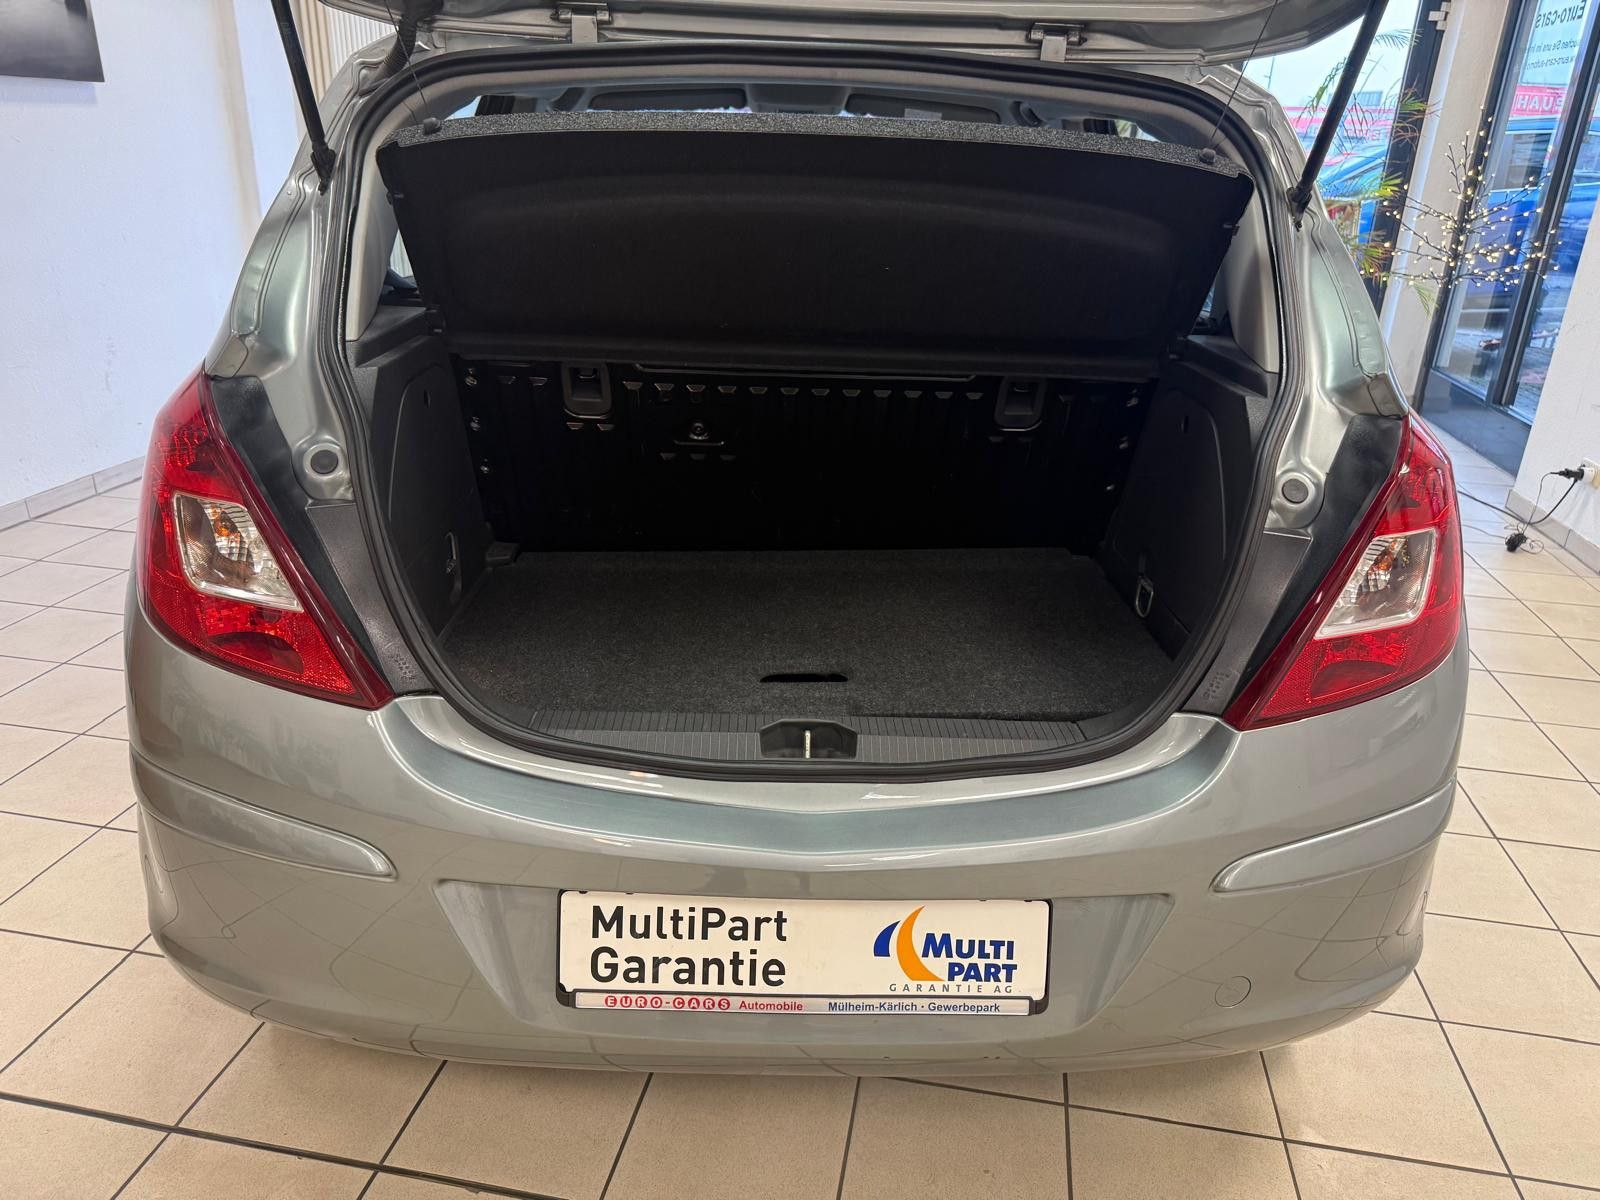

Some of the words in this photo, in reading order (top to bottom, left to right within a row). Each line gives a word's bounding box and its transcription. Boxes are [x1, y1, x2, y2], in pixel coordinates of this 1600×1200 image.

[591, 905, 788, 942] MultiPart
[921, 932, 1015, 961] MULTI
[590, 946, 786, 987] Garantie
[947, 961, 1018, 983] PART
[889, 983, 982, 993] GARANTIE
[993, 985, 1013, 994] AG
[604, 995, 731, 1011] EURO-CARS
[738, 1000, 804, 1012] Automobile
[828, 1001, 918, 1013] Mülheim-Kärlich
[927, 1001, 1001, 1014] Gewerbepark
